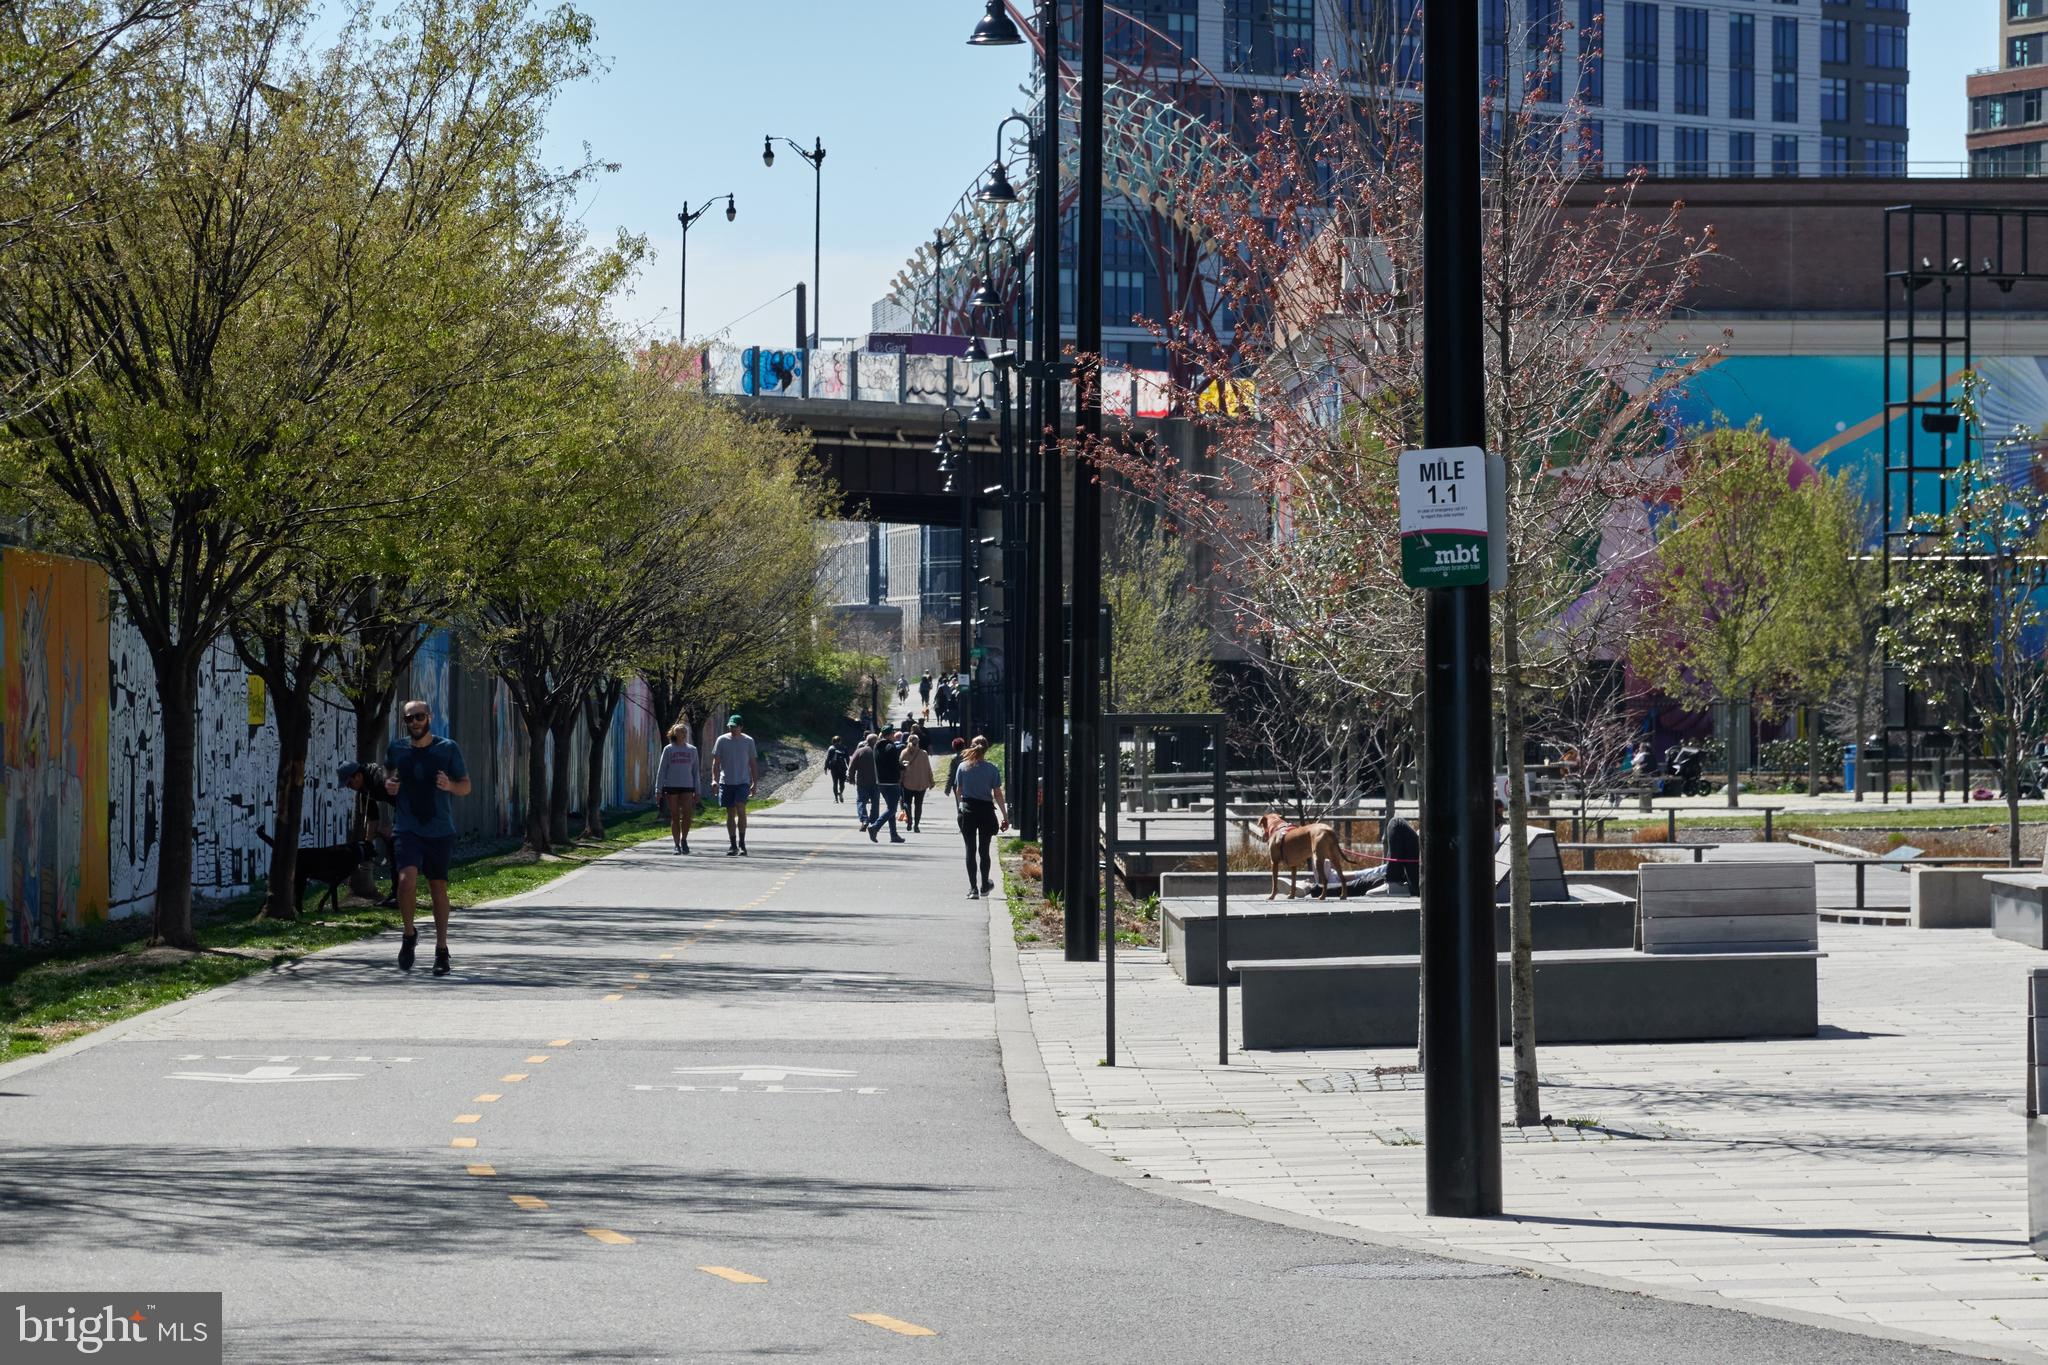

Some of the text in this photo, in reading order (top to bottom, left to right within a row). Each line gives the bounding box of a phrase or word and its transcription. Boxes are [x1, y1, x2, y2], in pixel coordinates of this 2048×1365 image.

[885, 342, 907, 353] Giant
[1420, 460, 1465, 482] MILE
[1427, 483, 1457, 504] 1.1
[1435, 544, 1480, 565] mbt
